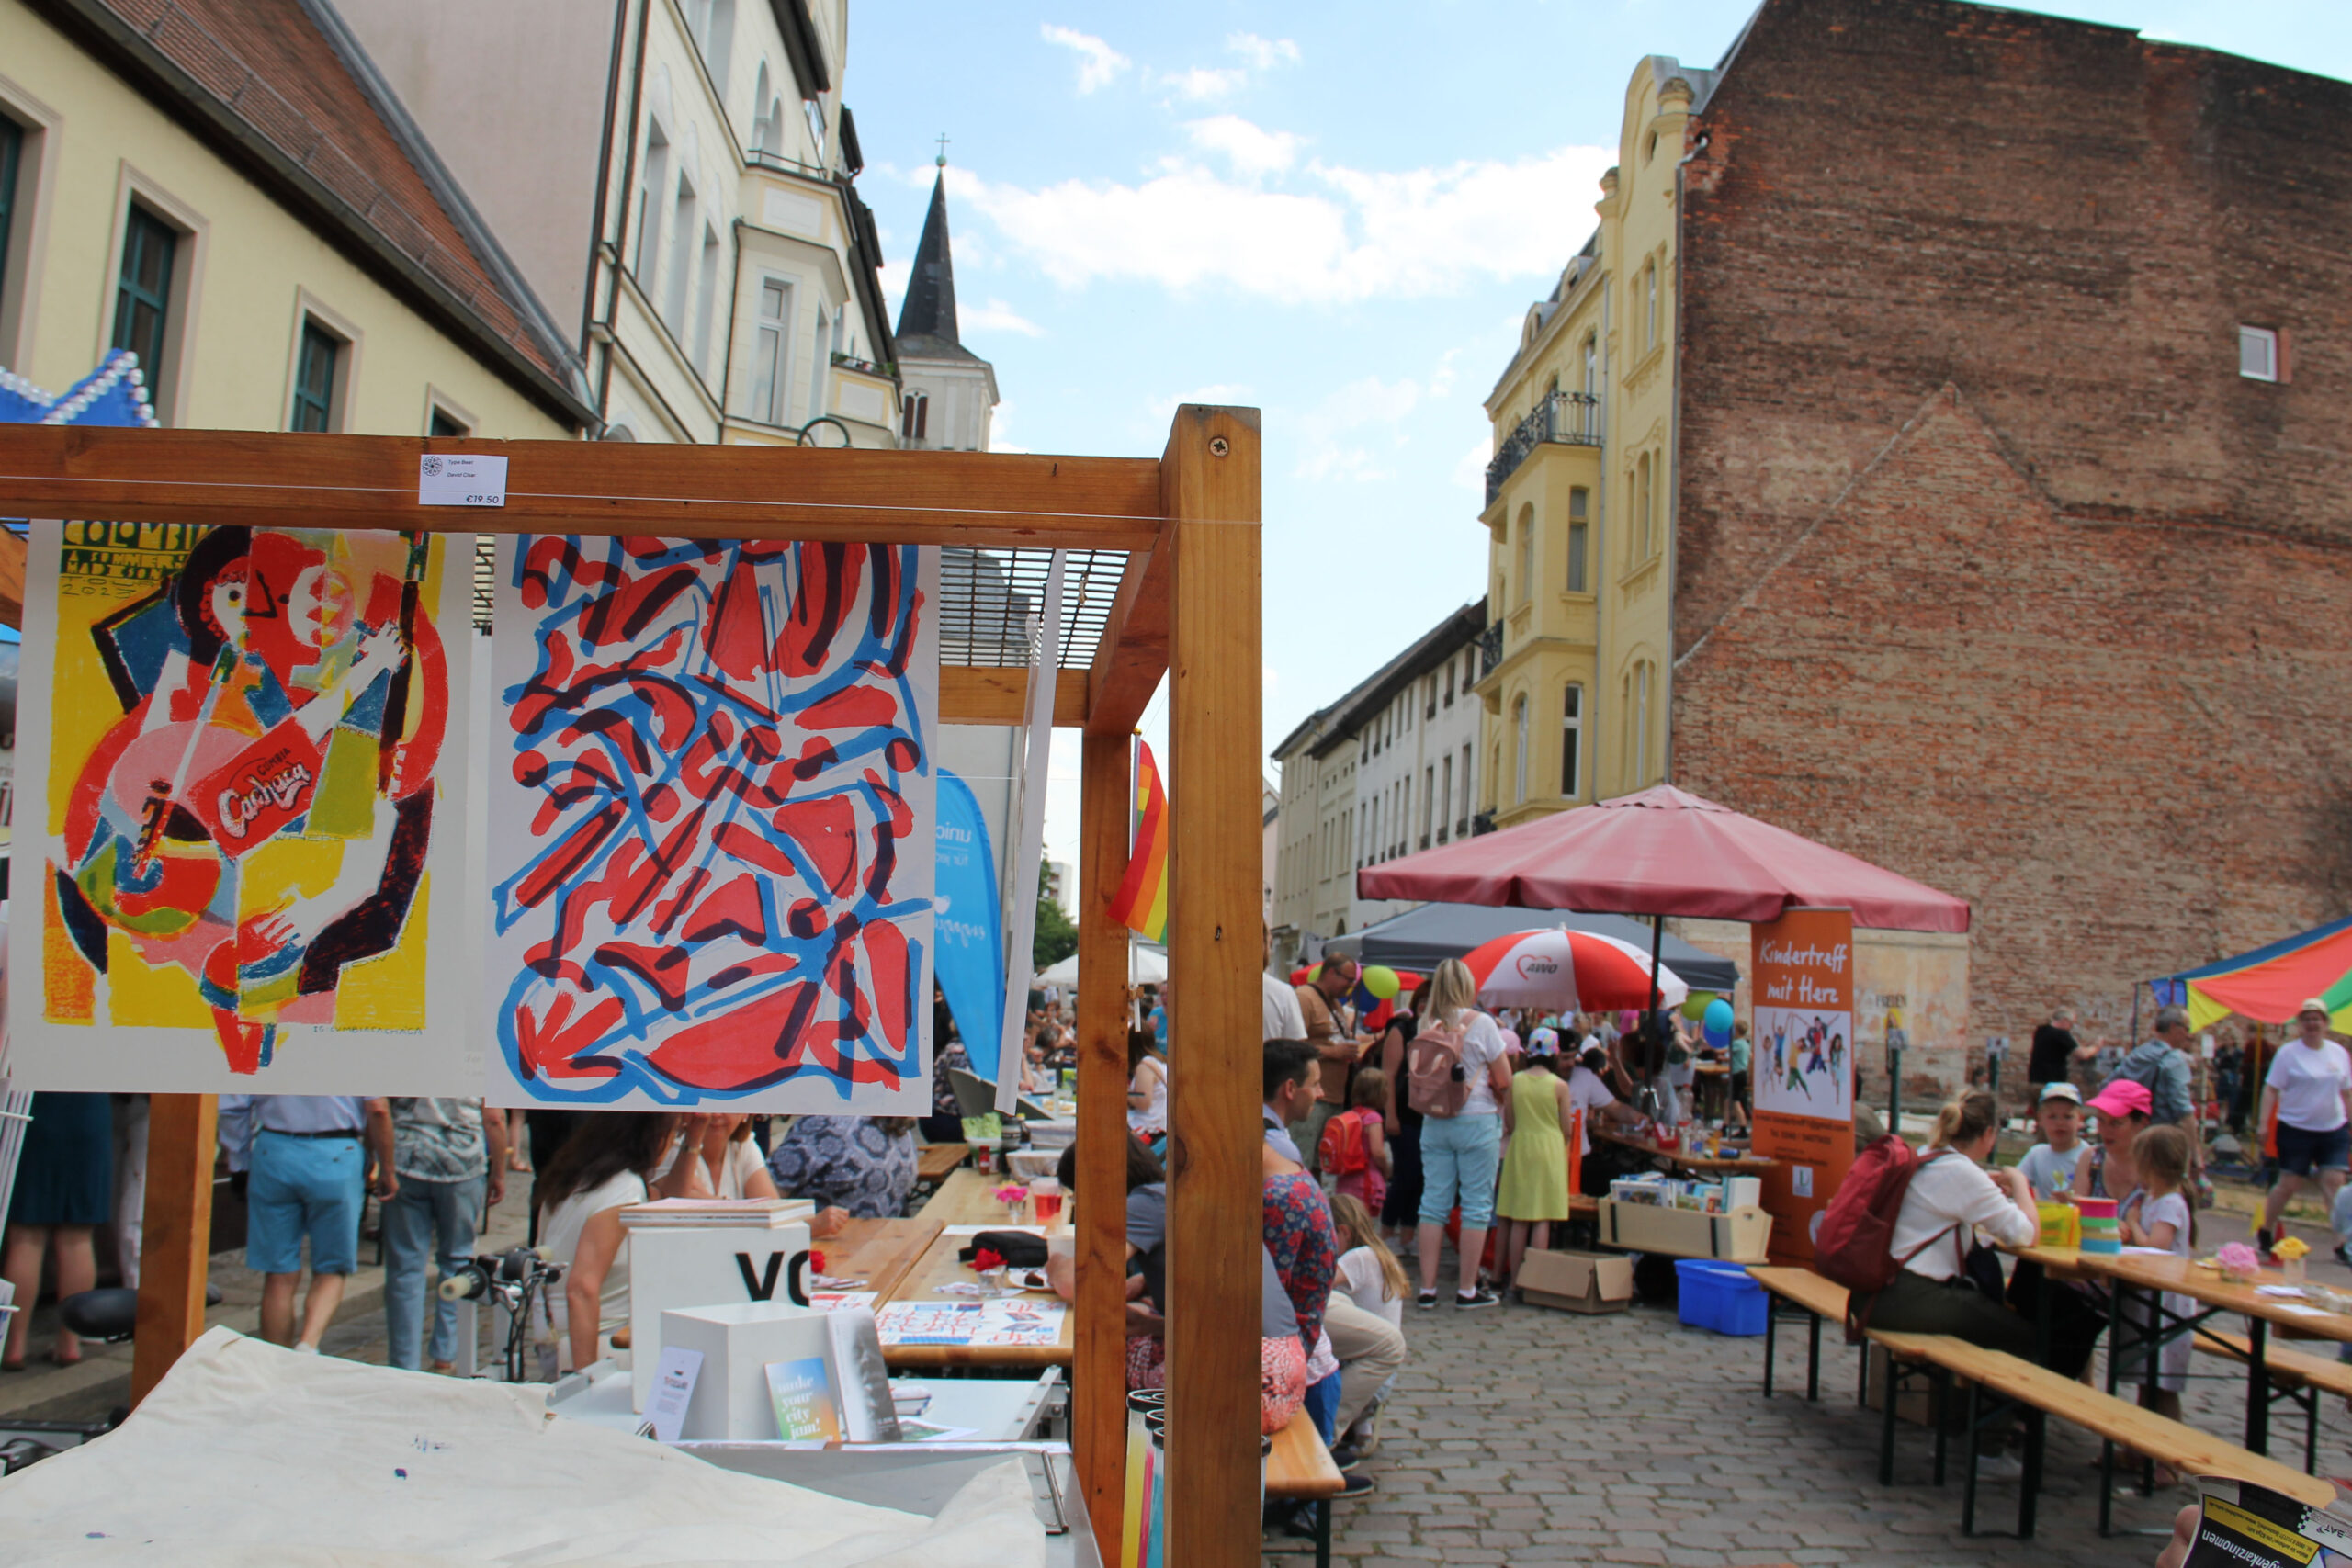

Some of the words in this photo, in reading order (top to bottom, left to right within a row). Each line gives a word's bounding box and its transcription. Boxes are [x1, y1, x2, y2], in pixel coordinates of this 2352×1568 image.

[466, 494, 500, 504] €19.50
[1759, 938, 1848, 974] Kindertreff
[1526, 962, 1558, 975] AWO
[1767, 975, 1793, 1002] mit
[1798, 974, 1839, 1004] Herz
